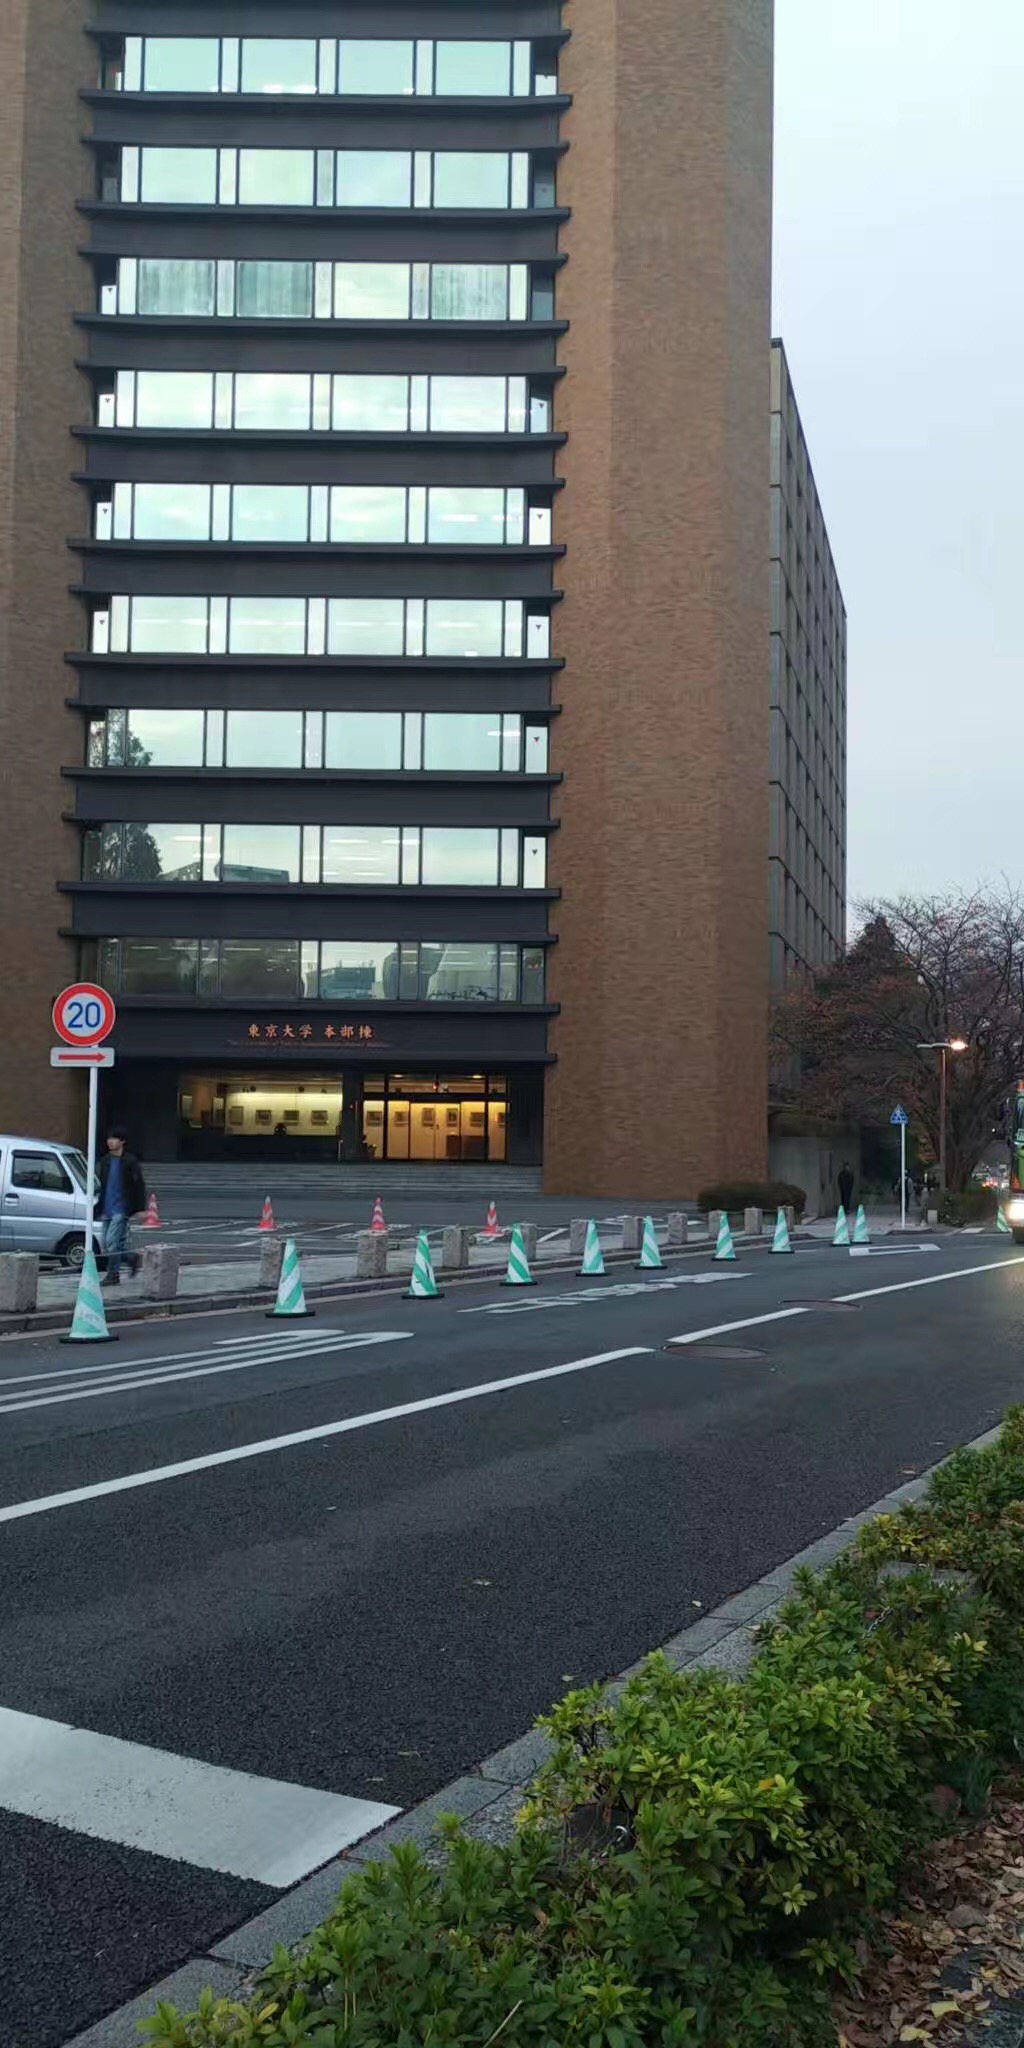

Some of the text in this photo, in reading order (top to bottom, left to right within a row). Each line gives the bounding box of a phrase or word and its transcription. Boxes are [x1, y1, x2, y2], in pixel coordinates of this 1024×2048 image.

[67, 1002, 101, 1029] 20
[247, 1023, 313, 1039] 東京大学
